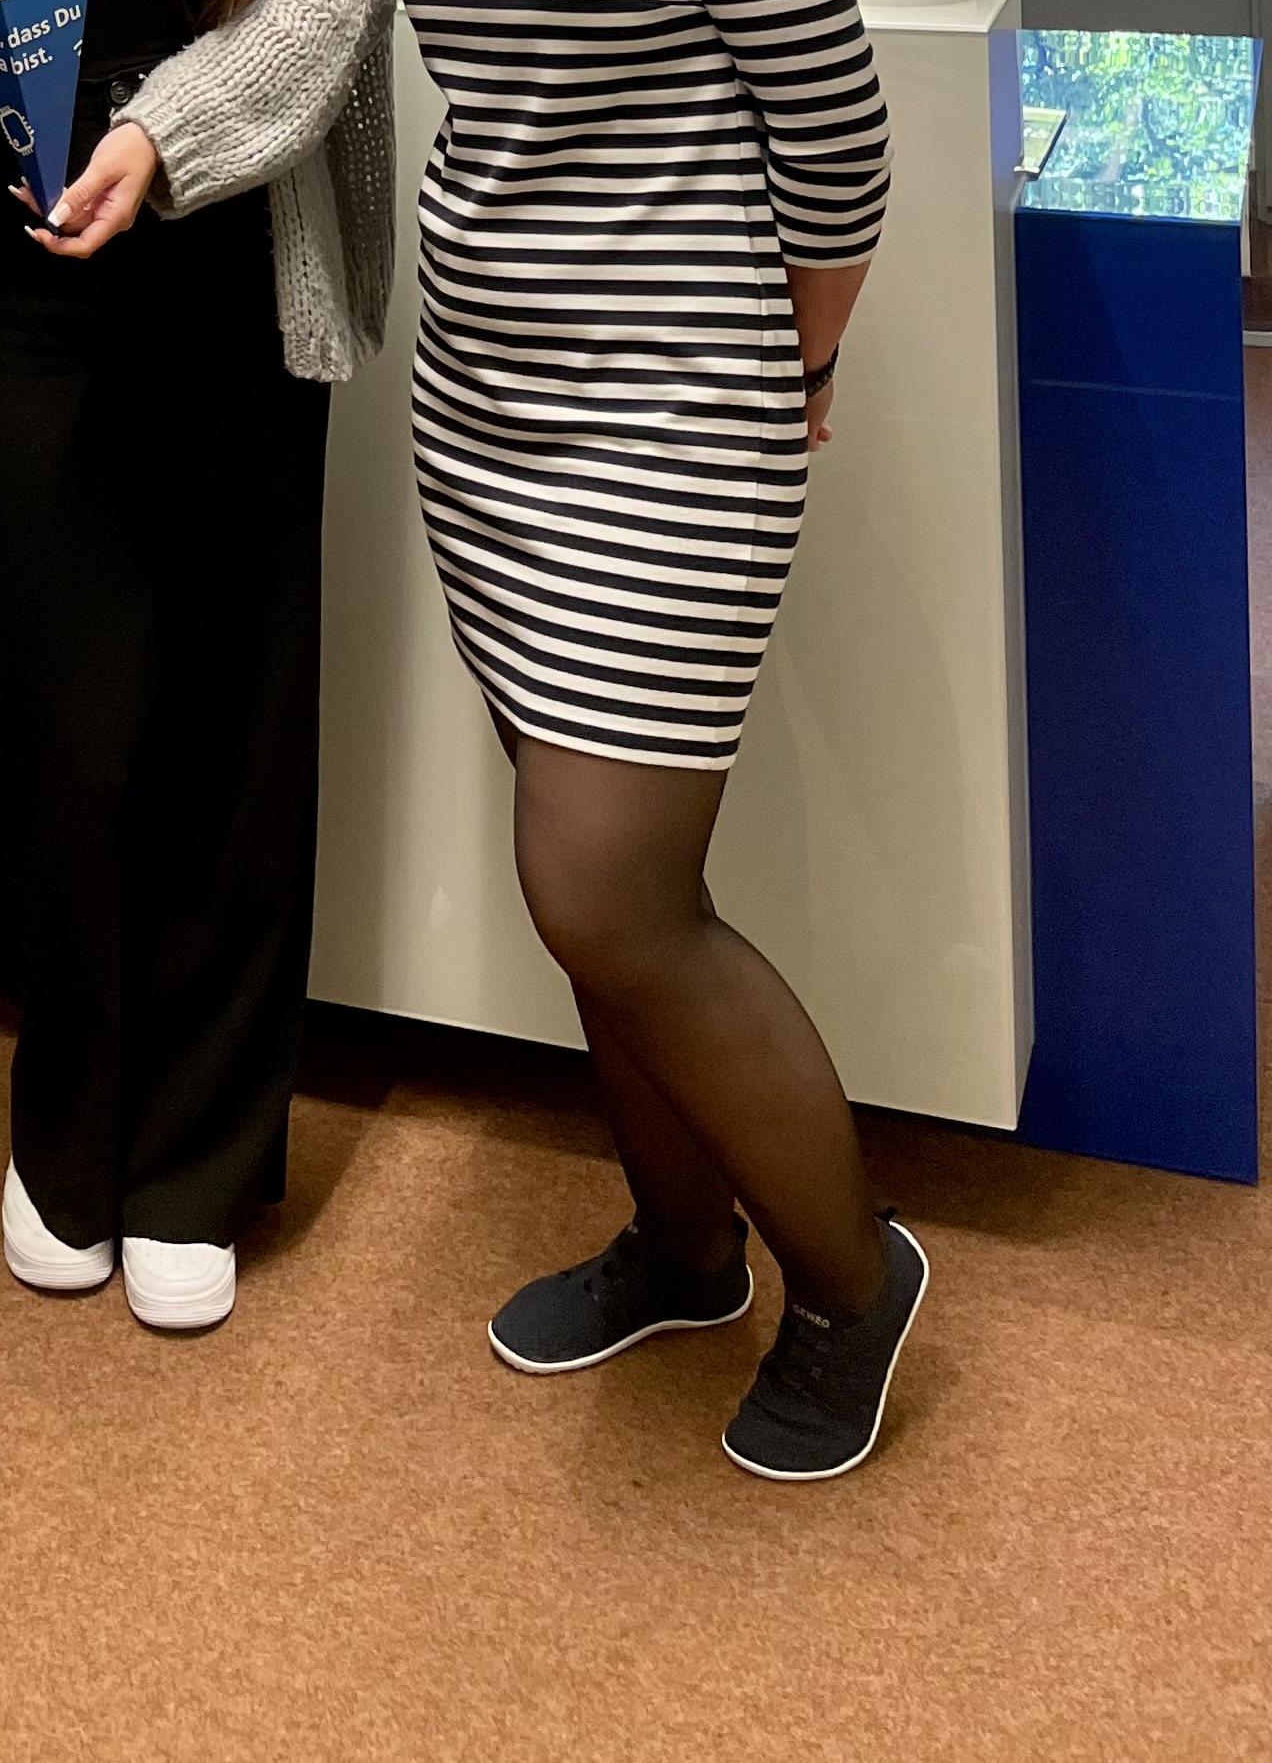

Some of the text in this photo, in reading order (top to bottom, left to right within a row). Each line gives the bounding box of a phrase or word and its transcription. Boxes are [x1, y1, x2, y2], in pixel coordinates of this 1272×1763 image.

[7, 19, 51, 48] dass
[54, 4, 82, 28] Du
[10, 47, 53, 75] bist.
